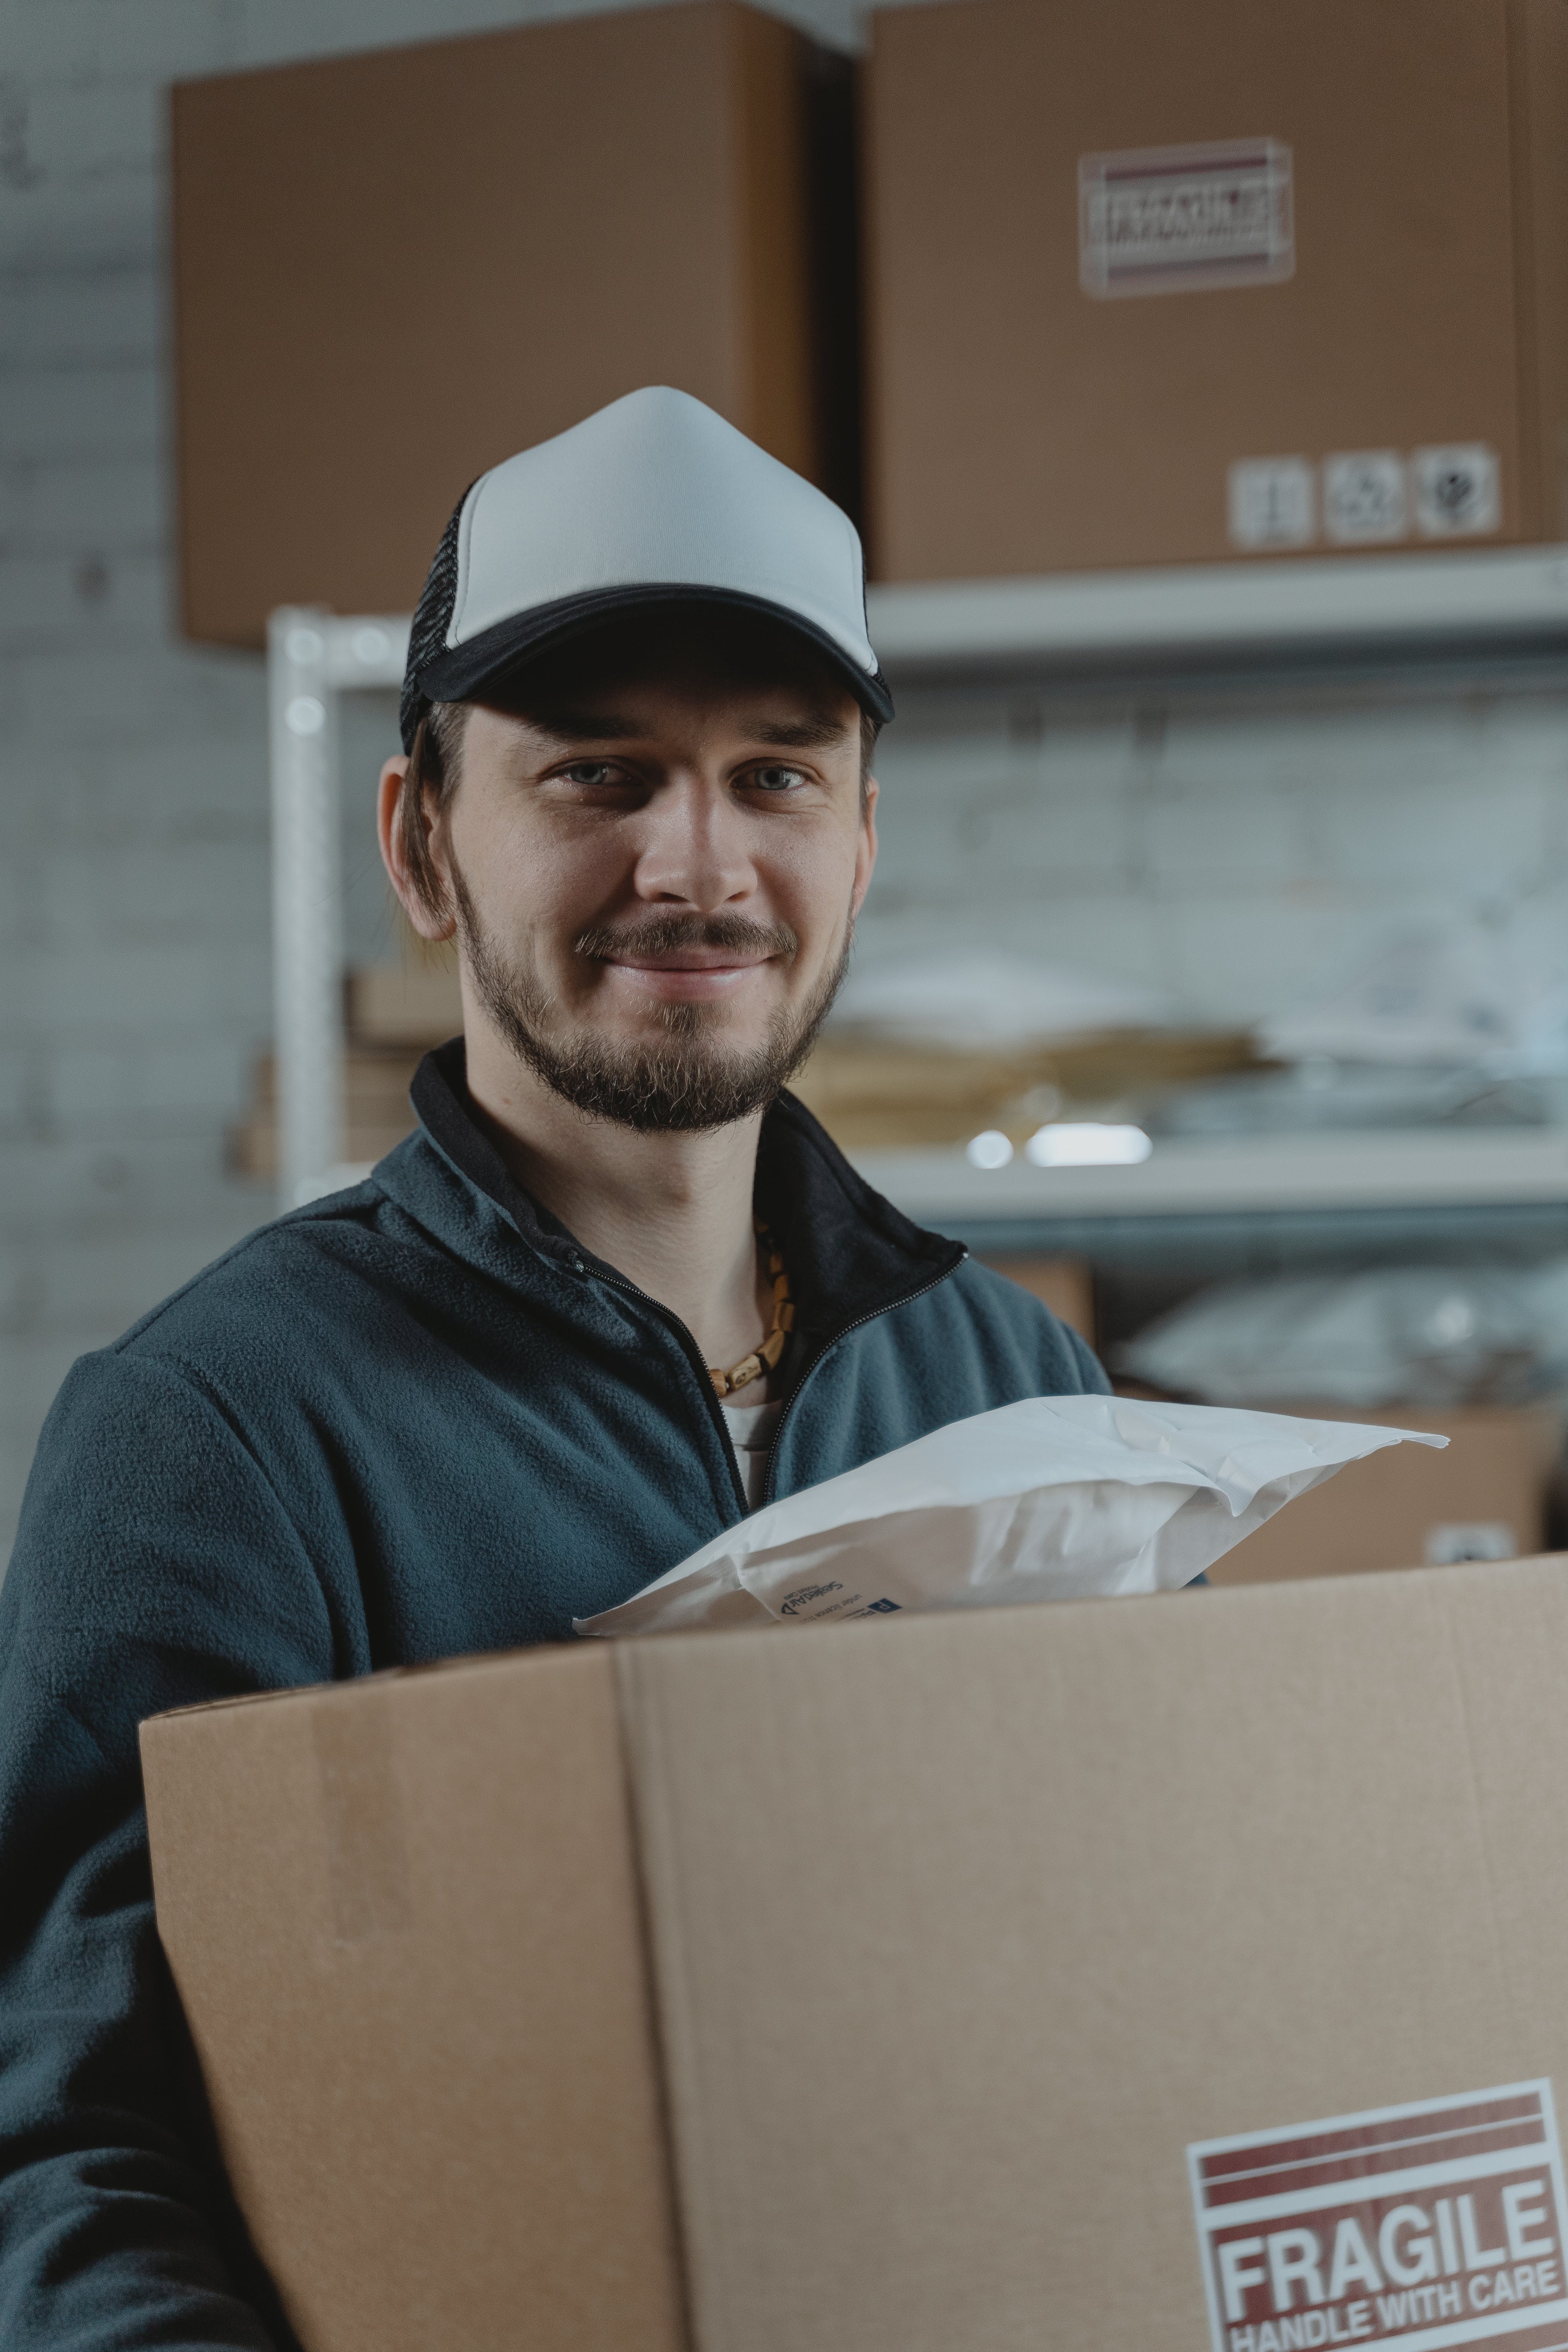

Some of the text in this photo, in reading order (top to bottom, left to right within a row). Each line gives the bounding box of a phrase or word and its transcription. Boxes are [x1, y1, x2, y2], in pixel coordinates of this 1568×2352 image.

[1218, 2179, 1555, 2322] FRAGILE
[1230, 2259, 1560, 2352] HANDLE WITH CARE
